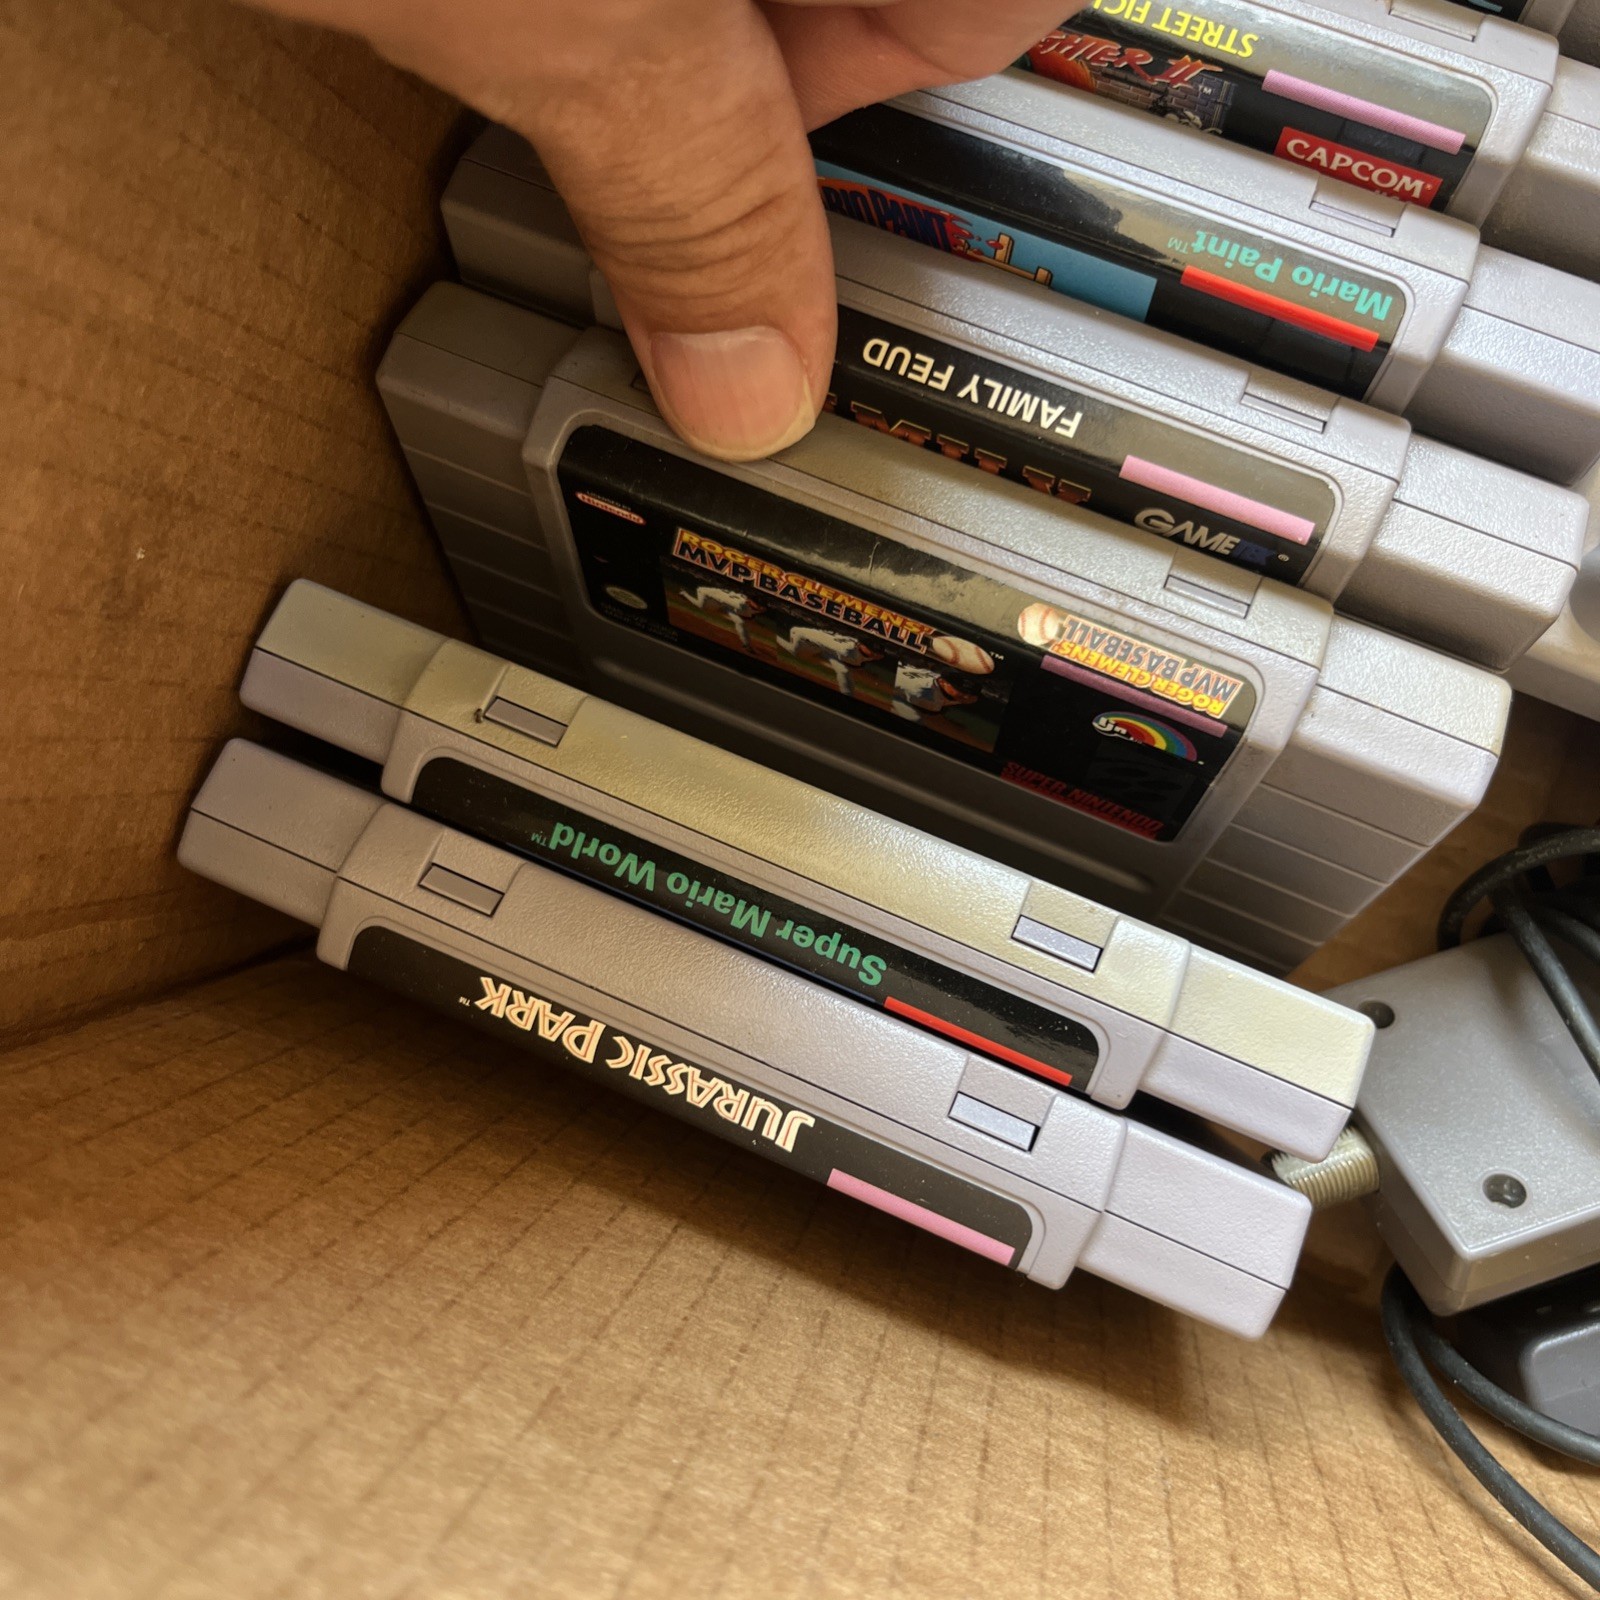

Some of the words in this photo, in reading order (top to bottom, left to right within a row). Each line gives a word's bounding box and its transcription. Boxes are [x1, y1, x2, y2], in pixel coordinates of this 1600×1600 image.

[1152, 7, 1259, 58] STREET
[1286, 138, 1426, 199] CAPCOM
[1191, 230, 1284, 283] Paint
[1291, 265, 1393, 322] Mario
[862, 338, 955, 392] FEUD
[957, 374, 1083, 439] FAMILY
[581, 493, 643, 524] Nintendo
[681, 531, 785, 580] ROGER
[677, 541, 751, 579] MVP
[759, 573, 928, 650] BASEBALL
[1067, 619, 1180, 677] BASEBALL
[1151, 679, 1226, 717] ROGER
[1180, 665, 1238, 701] MVP
[1002, 761, 1067, 795] SUPER
[1067, 788, 1165, 833] NINTENDO
[549, 822, 656, 892] World
[666, 872, 772, 938] Mario
[775, 919, 887, 986] Super
[474, 976, 606, 1064] PARK
[605, 1036, 816, 1153] JURASSIC
